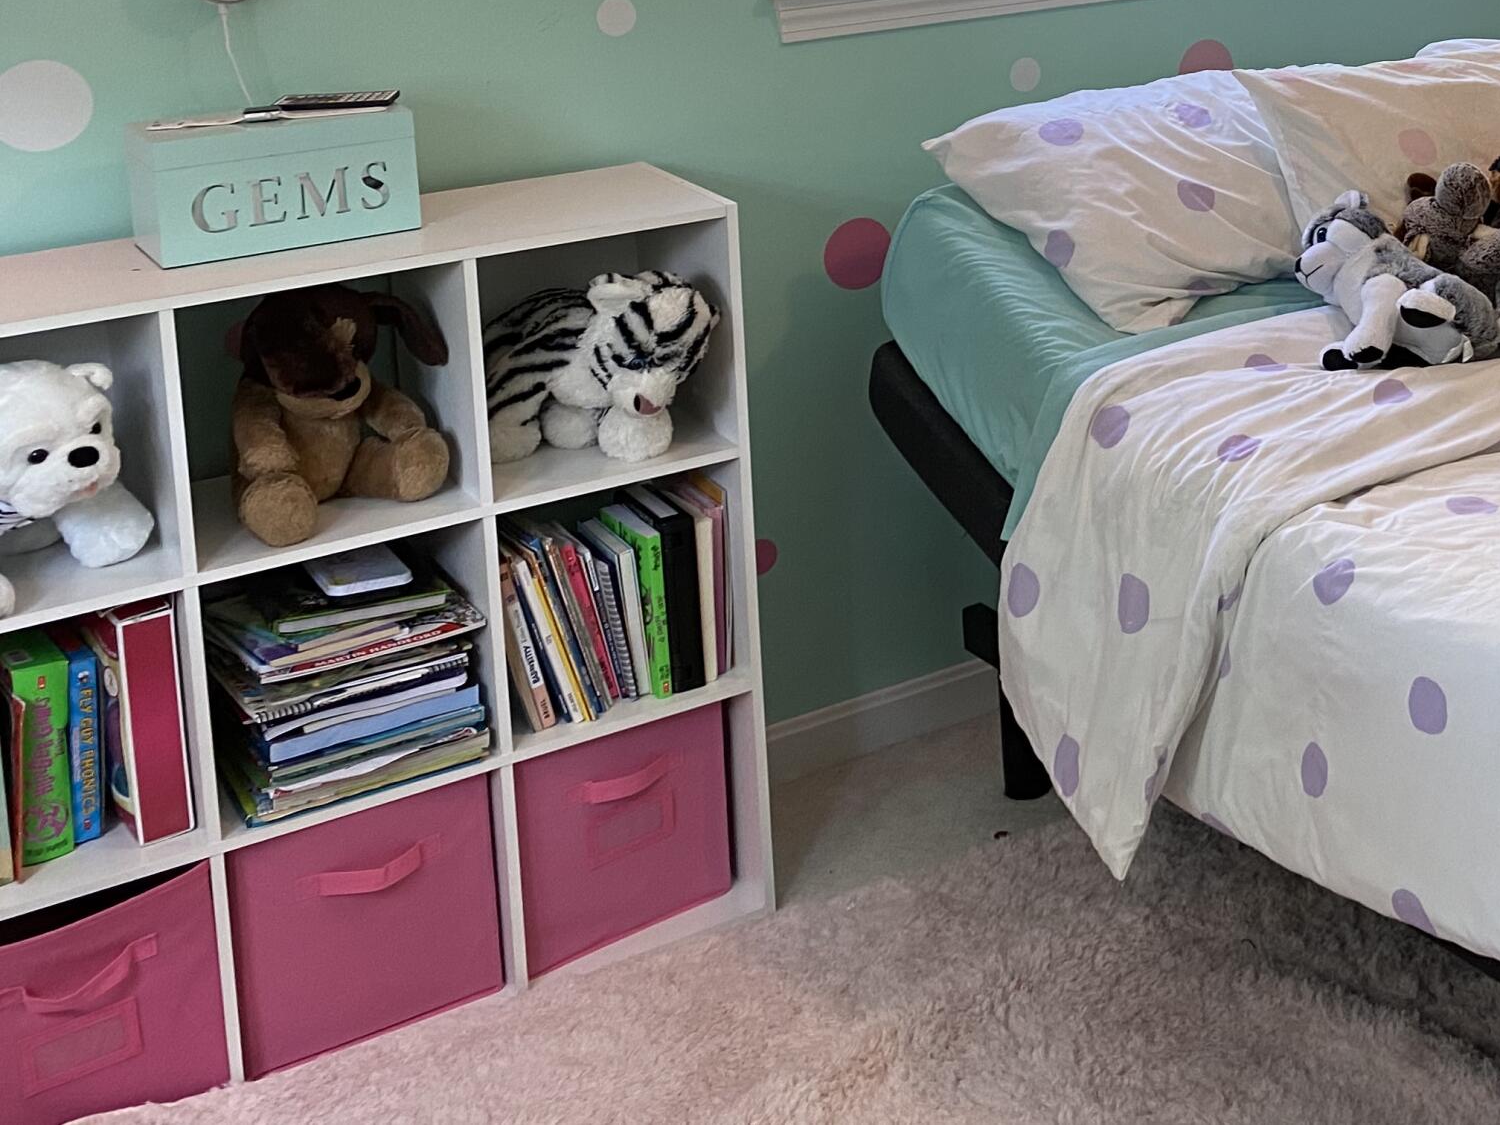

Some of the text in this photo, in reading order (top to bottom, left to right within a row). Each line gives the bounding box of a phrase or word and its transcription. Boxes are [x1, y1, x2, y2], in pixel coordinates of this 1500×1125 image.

[191, 161, 391, 233] GEMS
[314, 628, 443, 668] MARTIN HANDFORD
[79, 688, 98, 815] FLY GUY PHONICS
